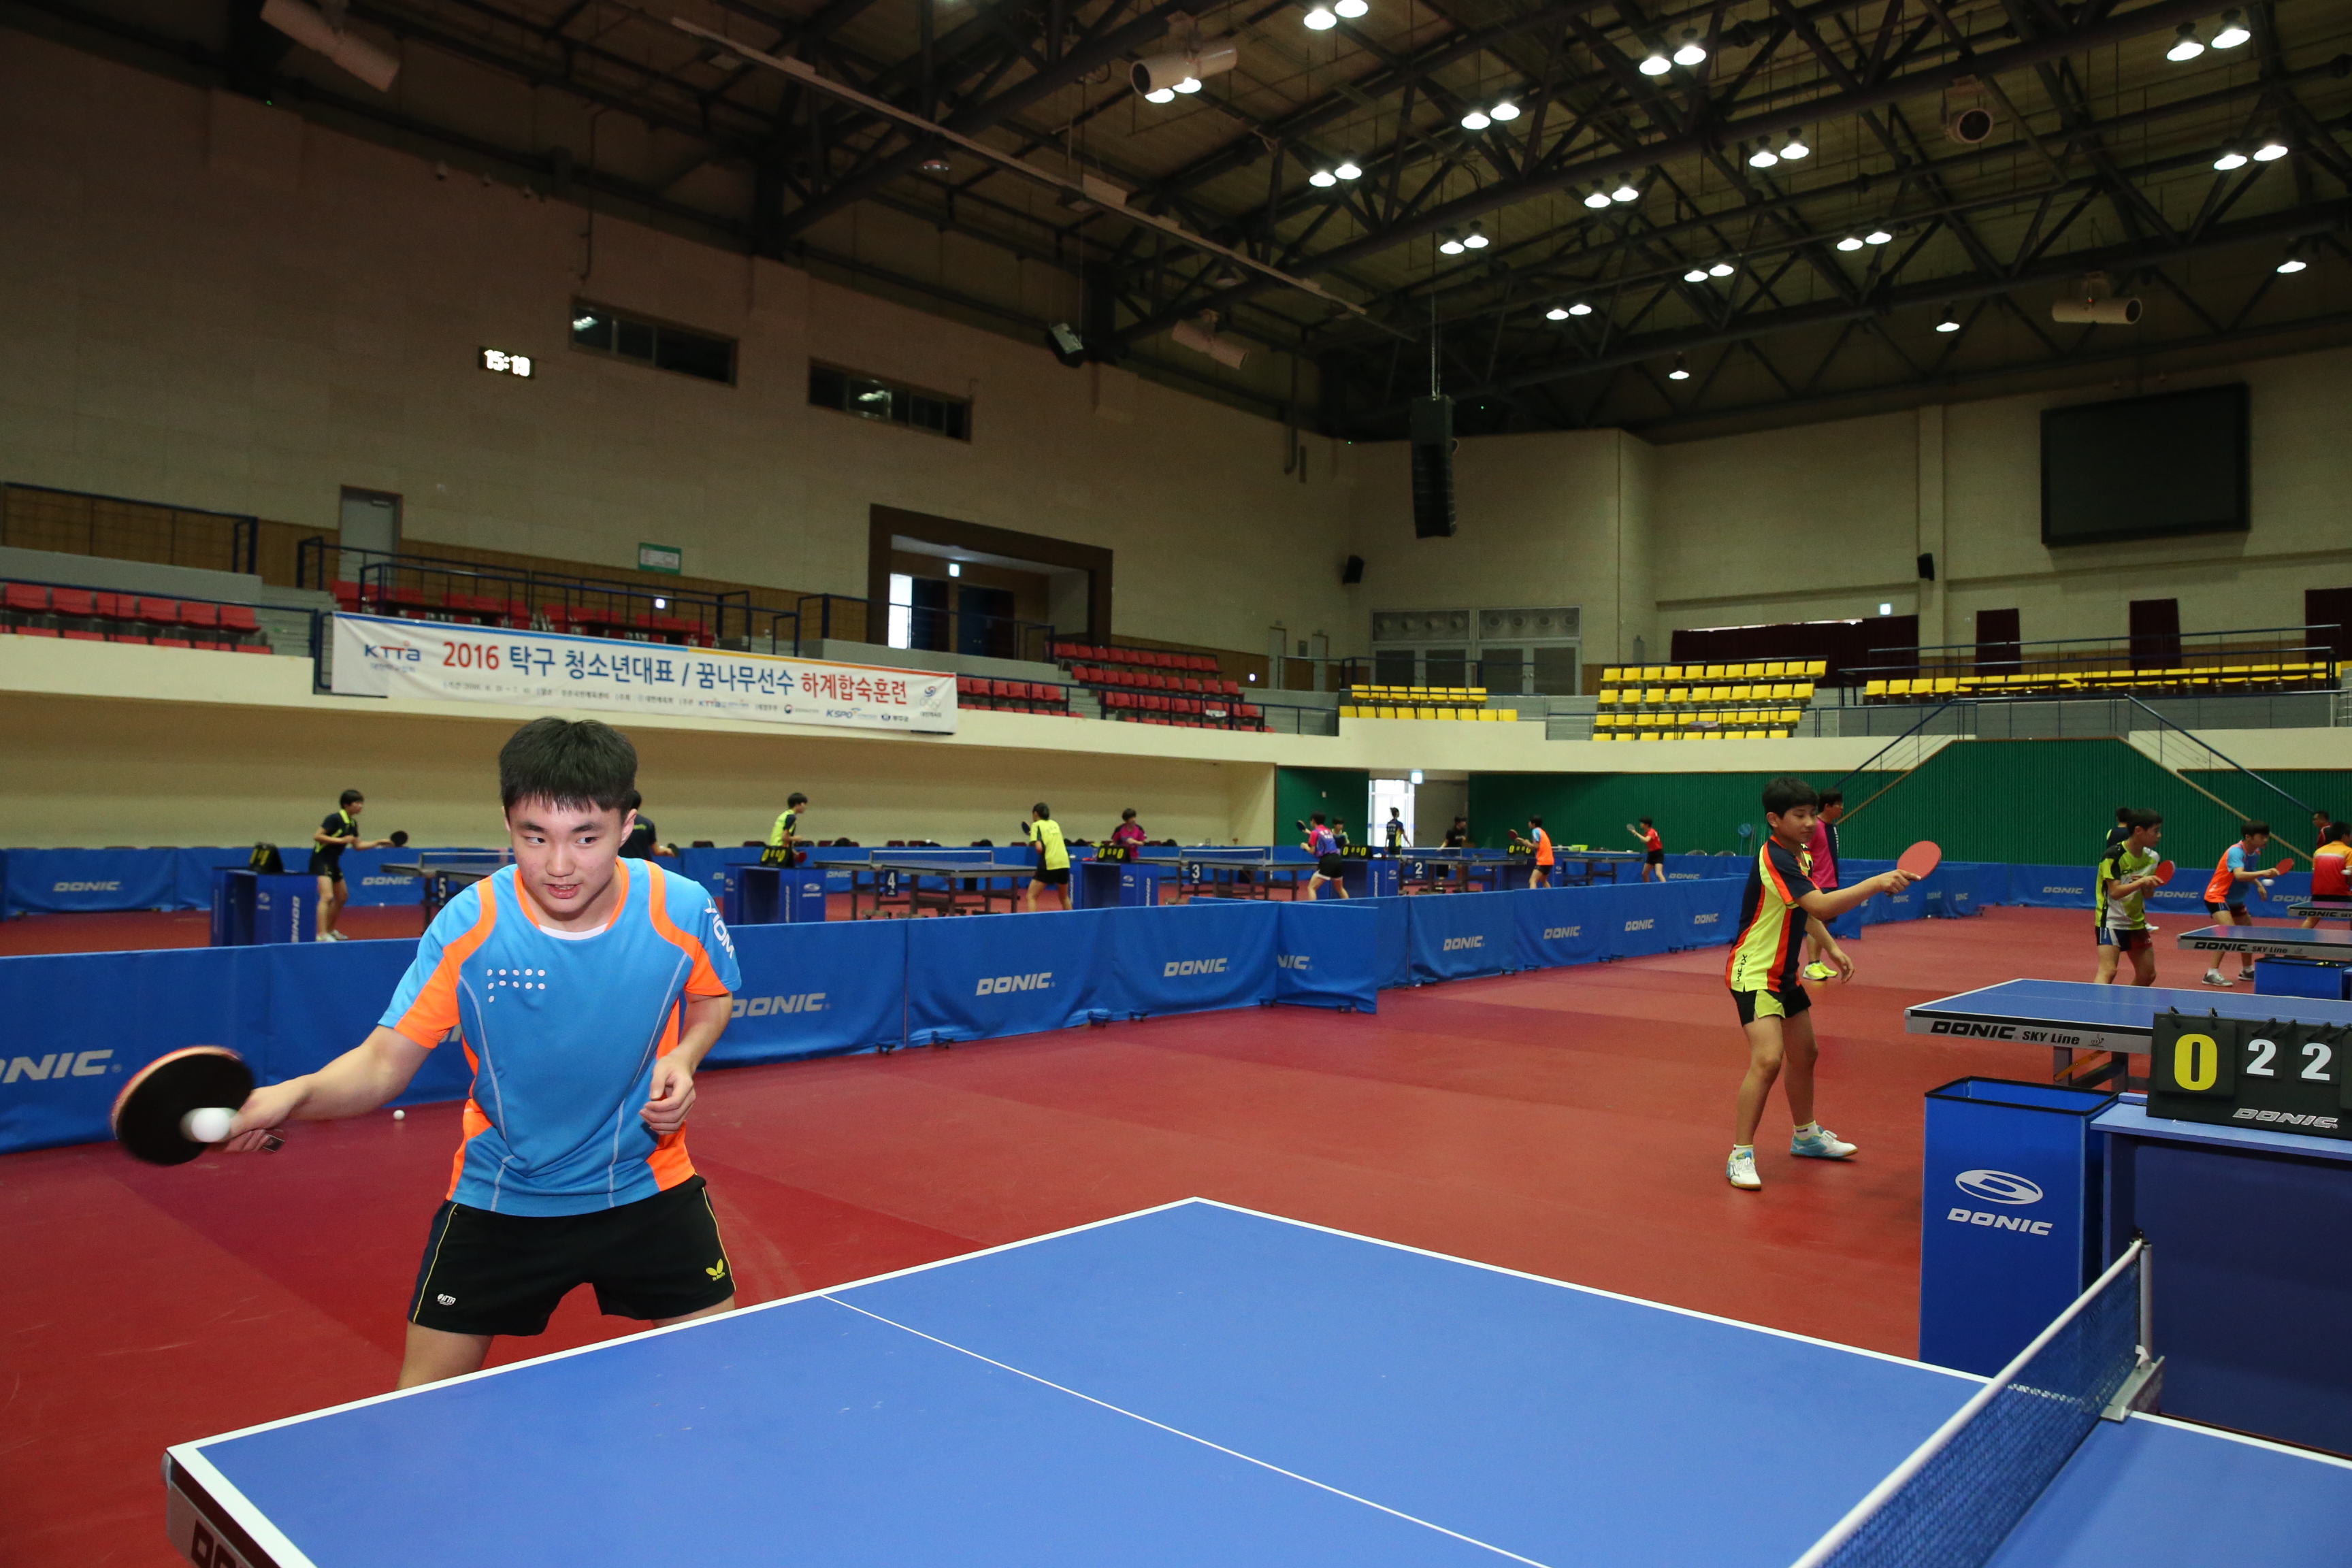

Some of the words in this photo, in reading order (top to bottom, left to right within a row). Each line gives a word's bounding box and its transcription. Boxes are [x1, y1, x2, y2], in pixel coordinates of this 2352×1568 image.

[444, 642, 500, 670] 2016
[510, 646, 556, 676] 탁구
[565, 650, 675, 685] 청소년대표
[696, 662, 795, 696] 꿈나무선수
[801, 673, 907, 705] 하계합숙훈련
[1192, 864, 1200, 879] 3
[1415, 862, 1423, 875] 2
[53, 881, 120, 892] DONIC
[362, 876, 414, 885] DONIC
[438, 877, 446, 898] 5
[887, 872, 896, 889] 4
[2042, 886, 2083, 894] DONIC
[2153, 891, 2198, 899] DONIC
[1624, 919, 1654, 931] DONIC
[1694, 913, 1719, 925] DONIC
[1543, 926, 1581, 939] DONIC
[1443, 935, 1484, 951] DONIC
[2194, 941, 2248, 951] DONIC
[1164, 958, 1228, 977] DONIC
[975, 972, 1052, 996] DONIC
[1930, 1021, 2016, 1040] DONIC
[2022, 1030, 2048, 1043] SKY
[2051, 1033, 2080, 1045] Line
[2174, 1034, 2217, 1091] 0
[2247, 1039, 2276, 1077] 2
[2301, 1043, 2332, 1081] 2
[2232, 1107, 2339, 1128] DONIC
[1947, 1207, 2053, 1236] DONIC
